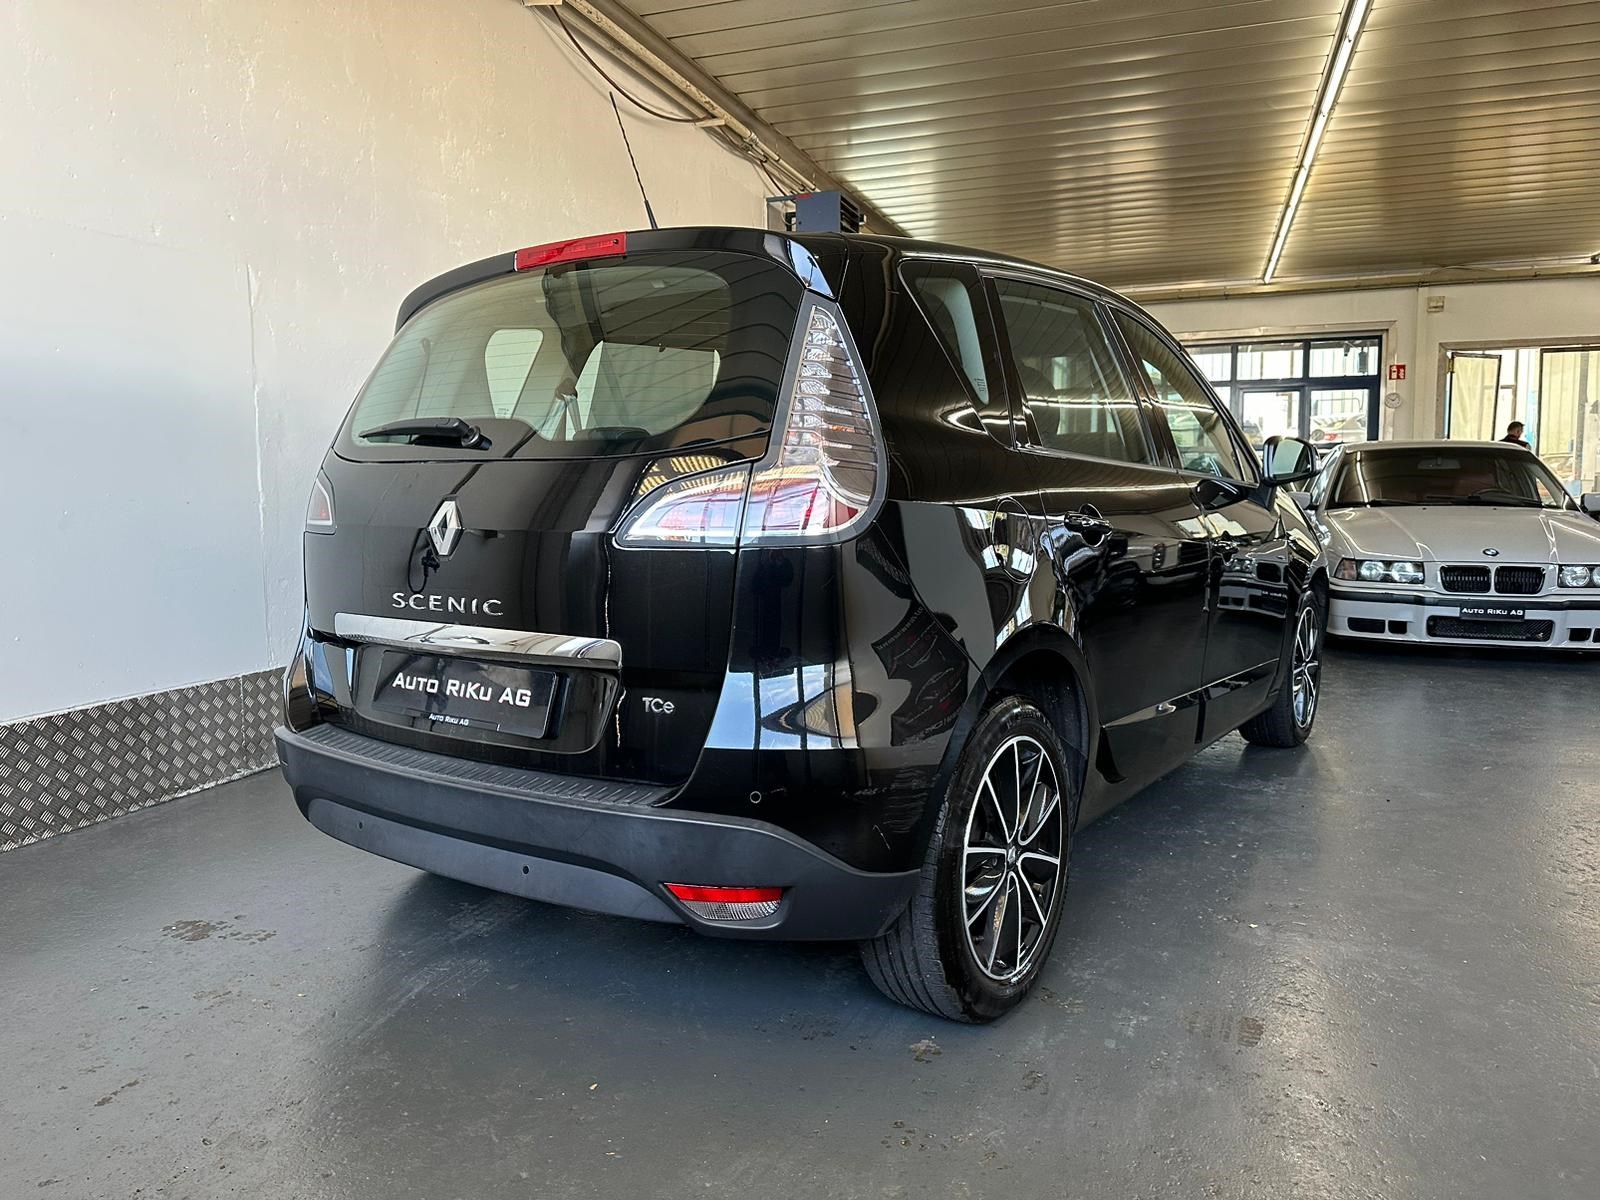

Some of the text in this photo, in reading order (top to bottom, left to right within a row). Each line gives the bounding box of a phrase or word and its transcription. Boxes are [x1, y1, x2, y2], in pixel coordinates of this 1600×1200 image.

[392, 592, 504, 616] SCENIC
[392, 672, 439, 694] AUTO
[498, 687, 532, 708] AG
[642, 697, 675, 714] TCe
[459, 718, 470, 726] AG
